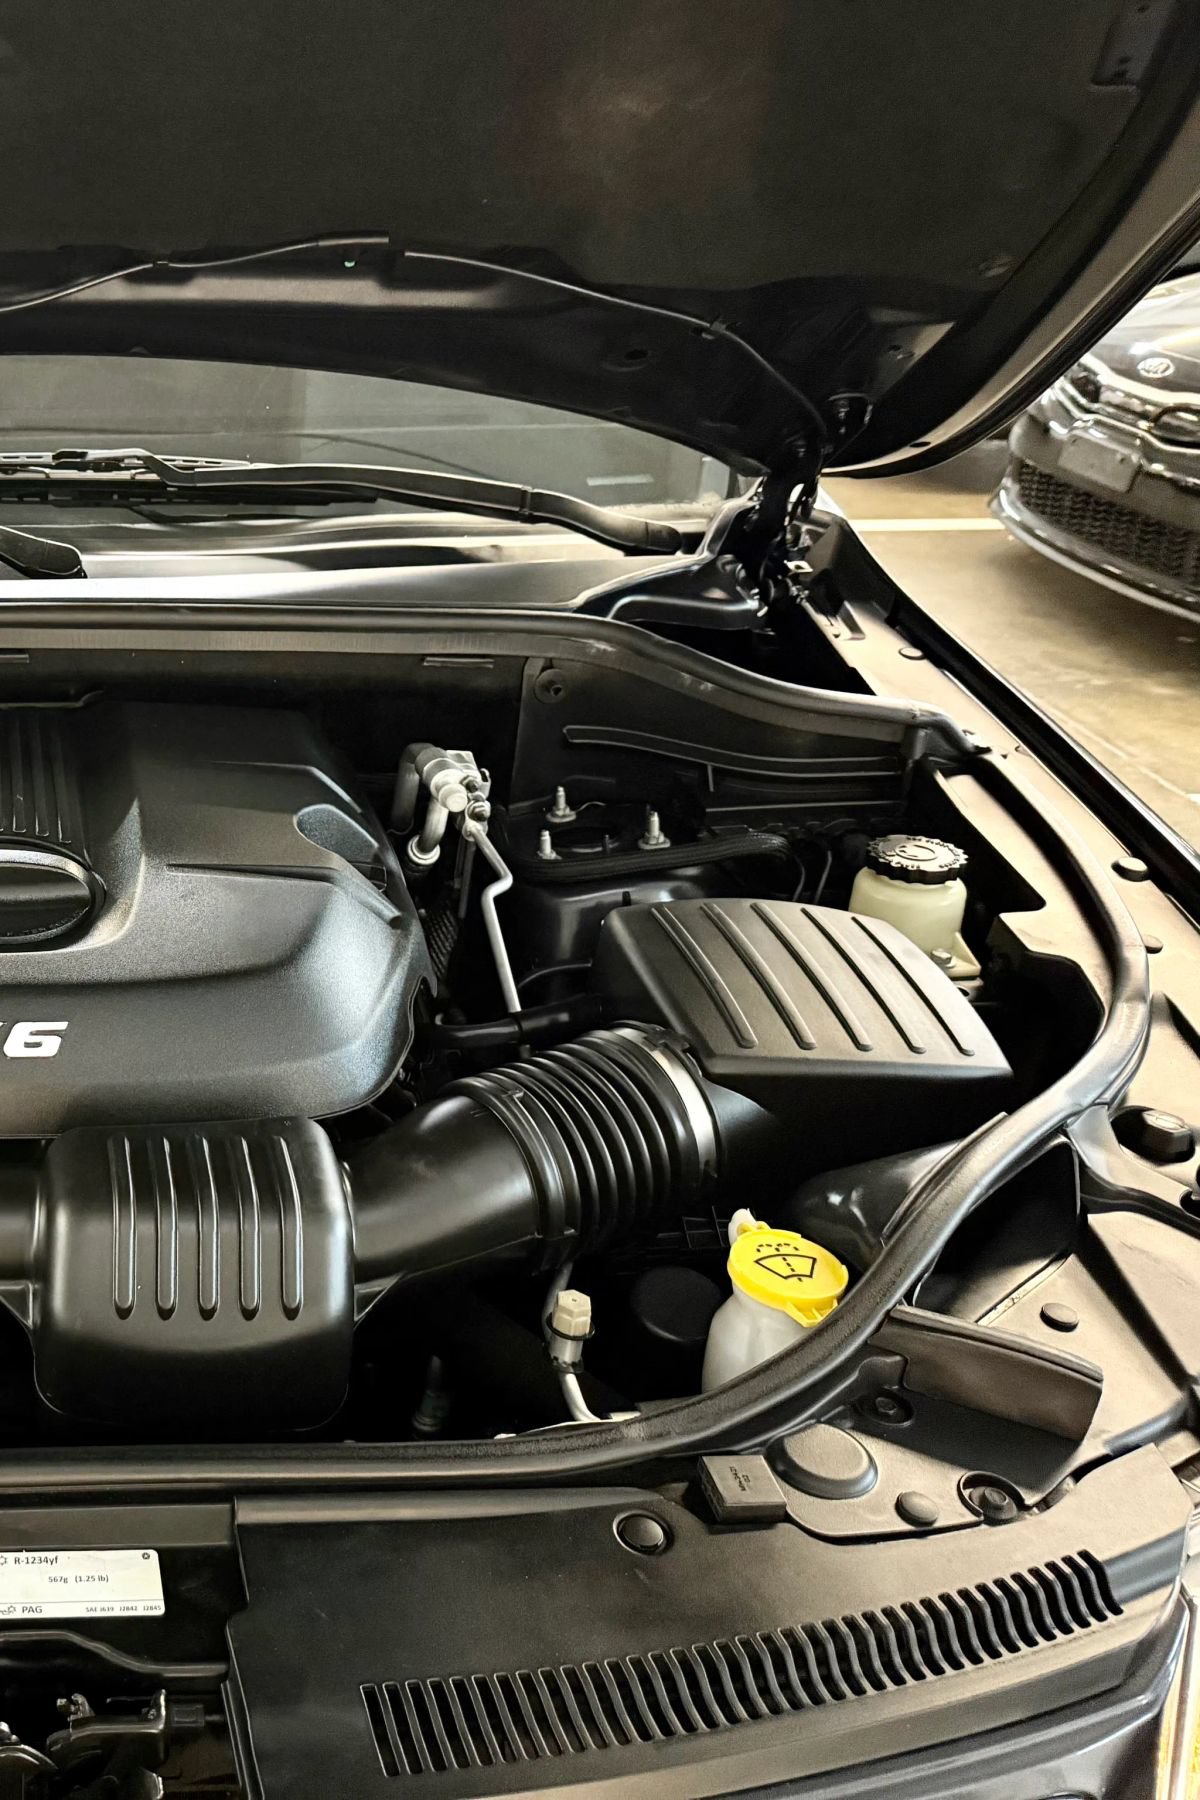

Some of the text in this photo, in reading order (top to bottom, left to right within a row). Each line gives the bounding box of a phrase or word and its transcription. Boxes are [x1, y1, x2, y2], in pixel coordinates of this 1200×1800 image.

[14, 1555, 59, 1566] R-1234yf
[48, 1574, 109, 1584] 567g (1.25 lb)
[21, 1605, 43, 1614] PAG
